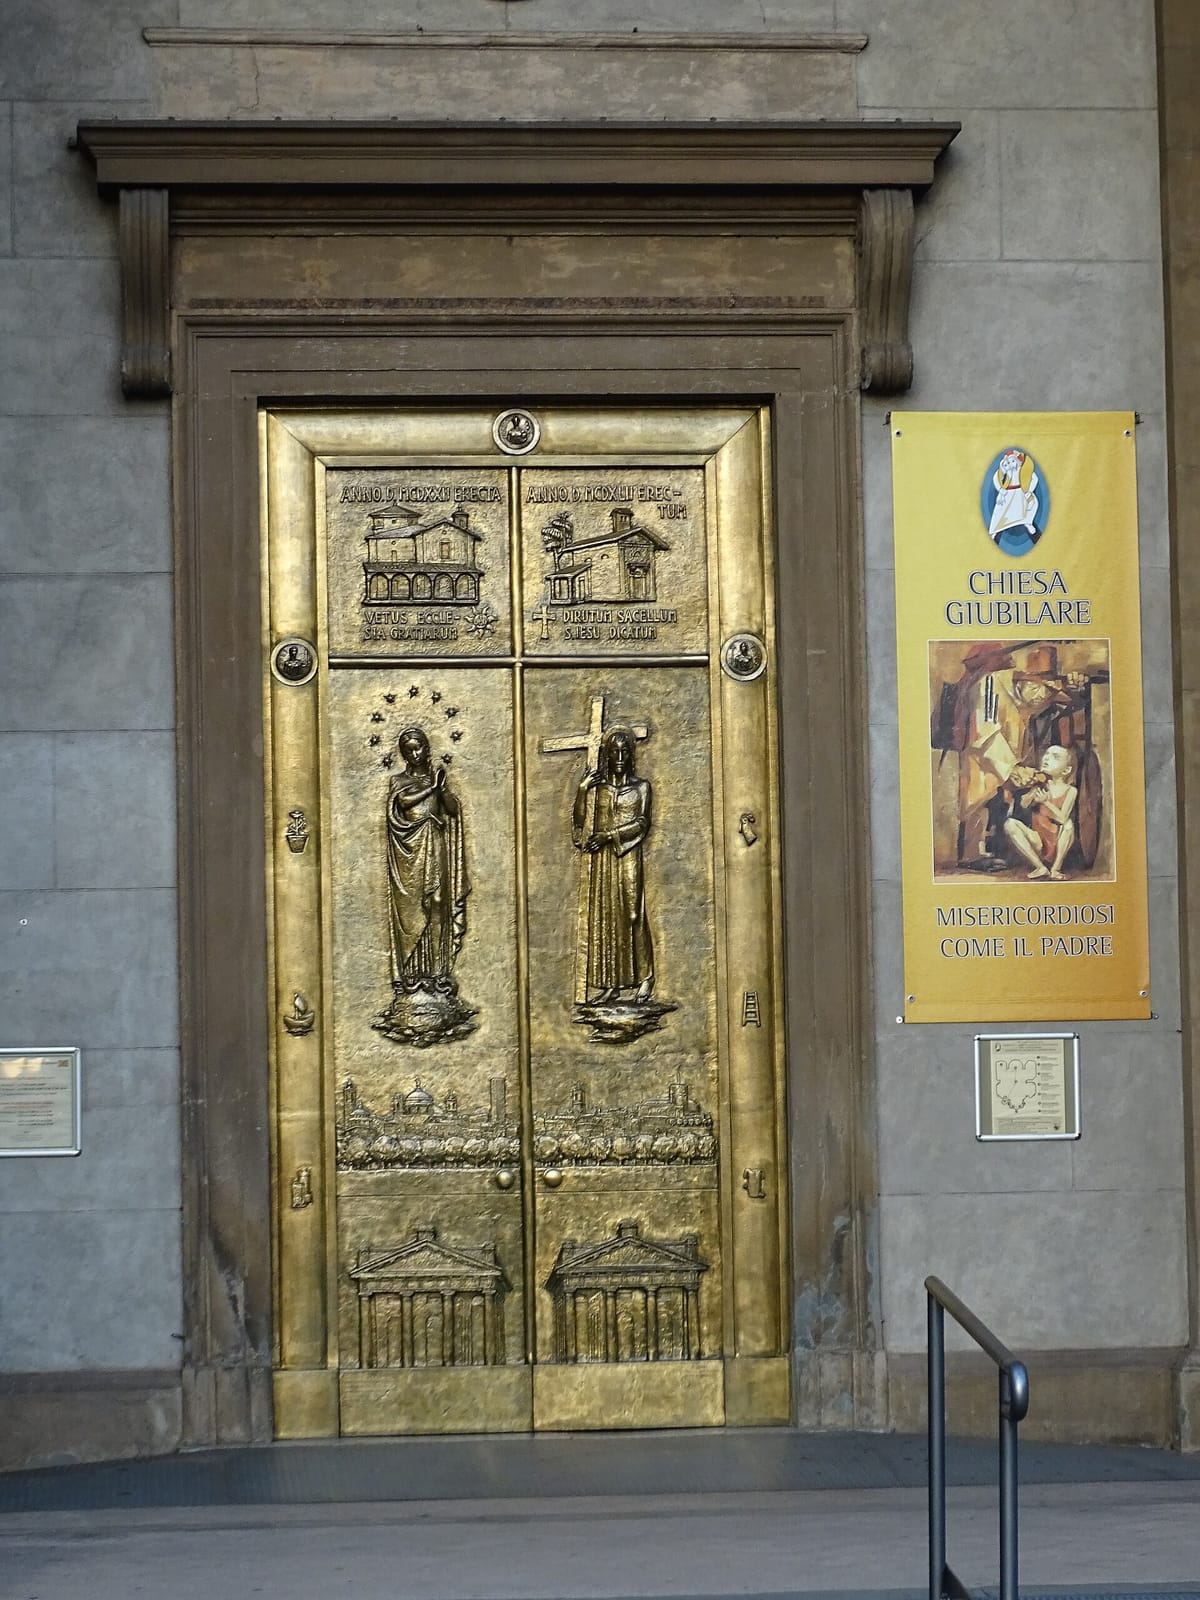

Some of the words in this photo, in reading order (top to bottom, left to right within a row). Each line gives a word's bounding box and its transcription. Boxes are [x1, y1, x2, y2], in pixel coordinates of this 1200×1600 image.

[453, 486, 502, 502] ERECTA
[657, 504, 688, 519] TUM
[968, 570, 1069, 596] CHIESA
[364, 611, 409, 625] VETUS
[563, 609, 613, 623] DIRUTUM
[617, 609, 678, 623] SACELLUM
[945, 600, 1092, 626] GIUBILARE
[364, 627, 387, 640] SIA
[390, 627, 459, 640] GRATIARUM
[609, 626, 658, 639] DICATUM
[936, 904, 1116, 928] MISERICORDIOSI
[940, 938, 1005, 958] COME
[1013, 938, 1034, 958] IL
[1041, 936, 1114, 957] PADRE
